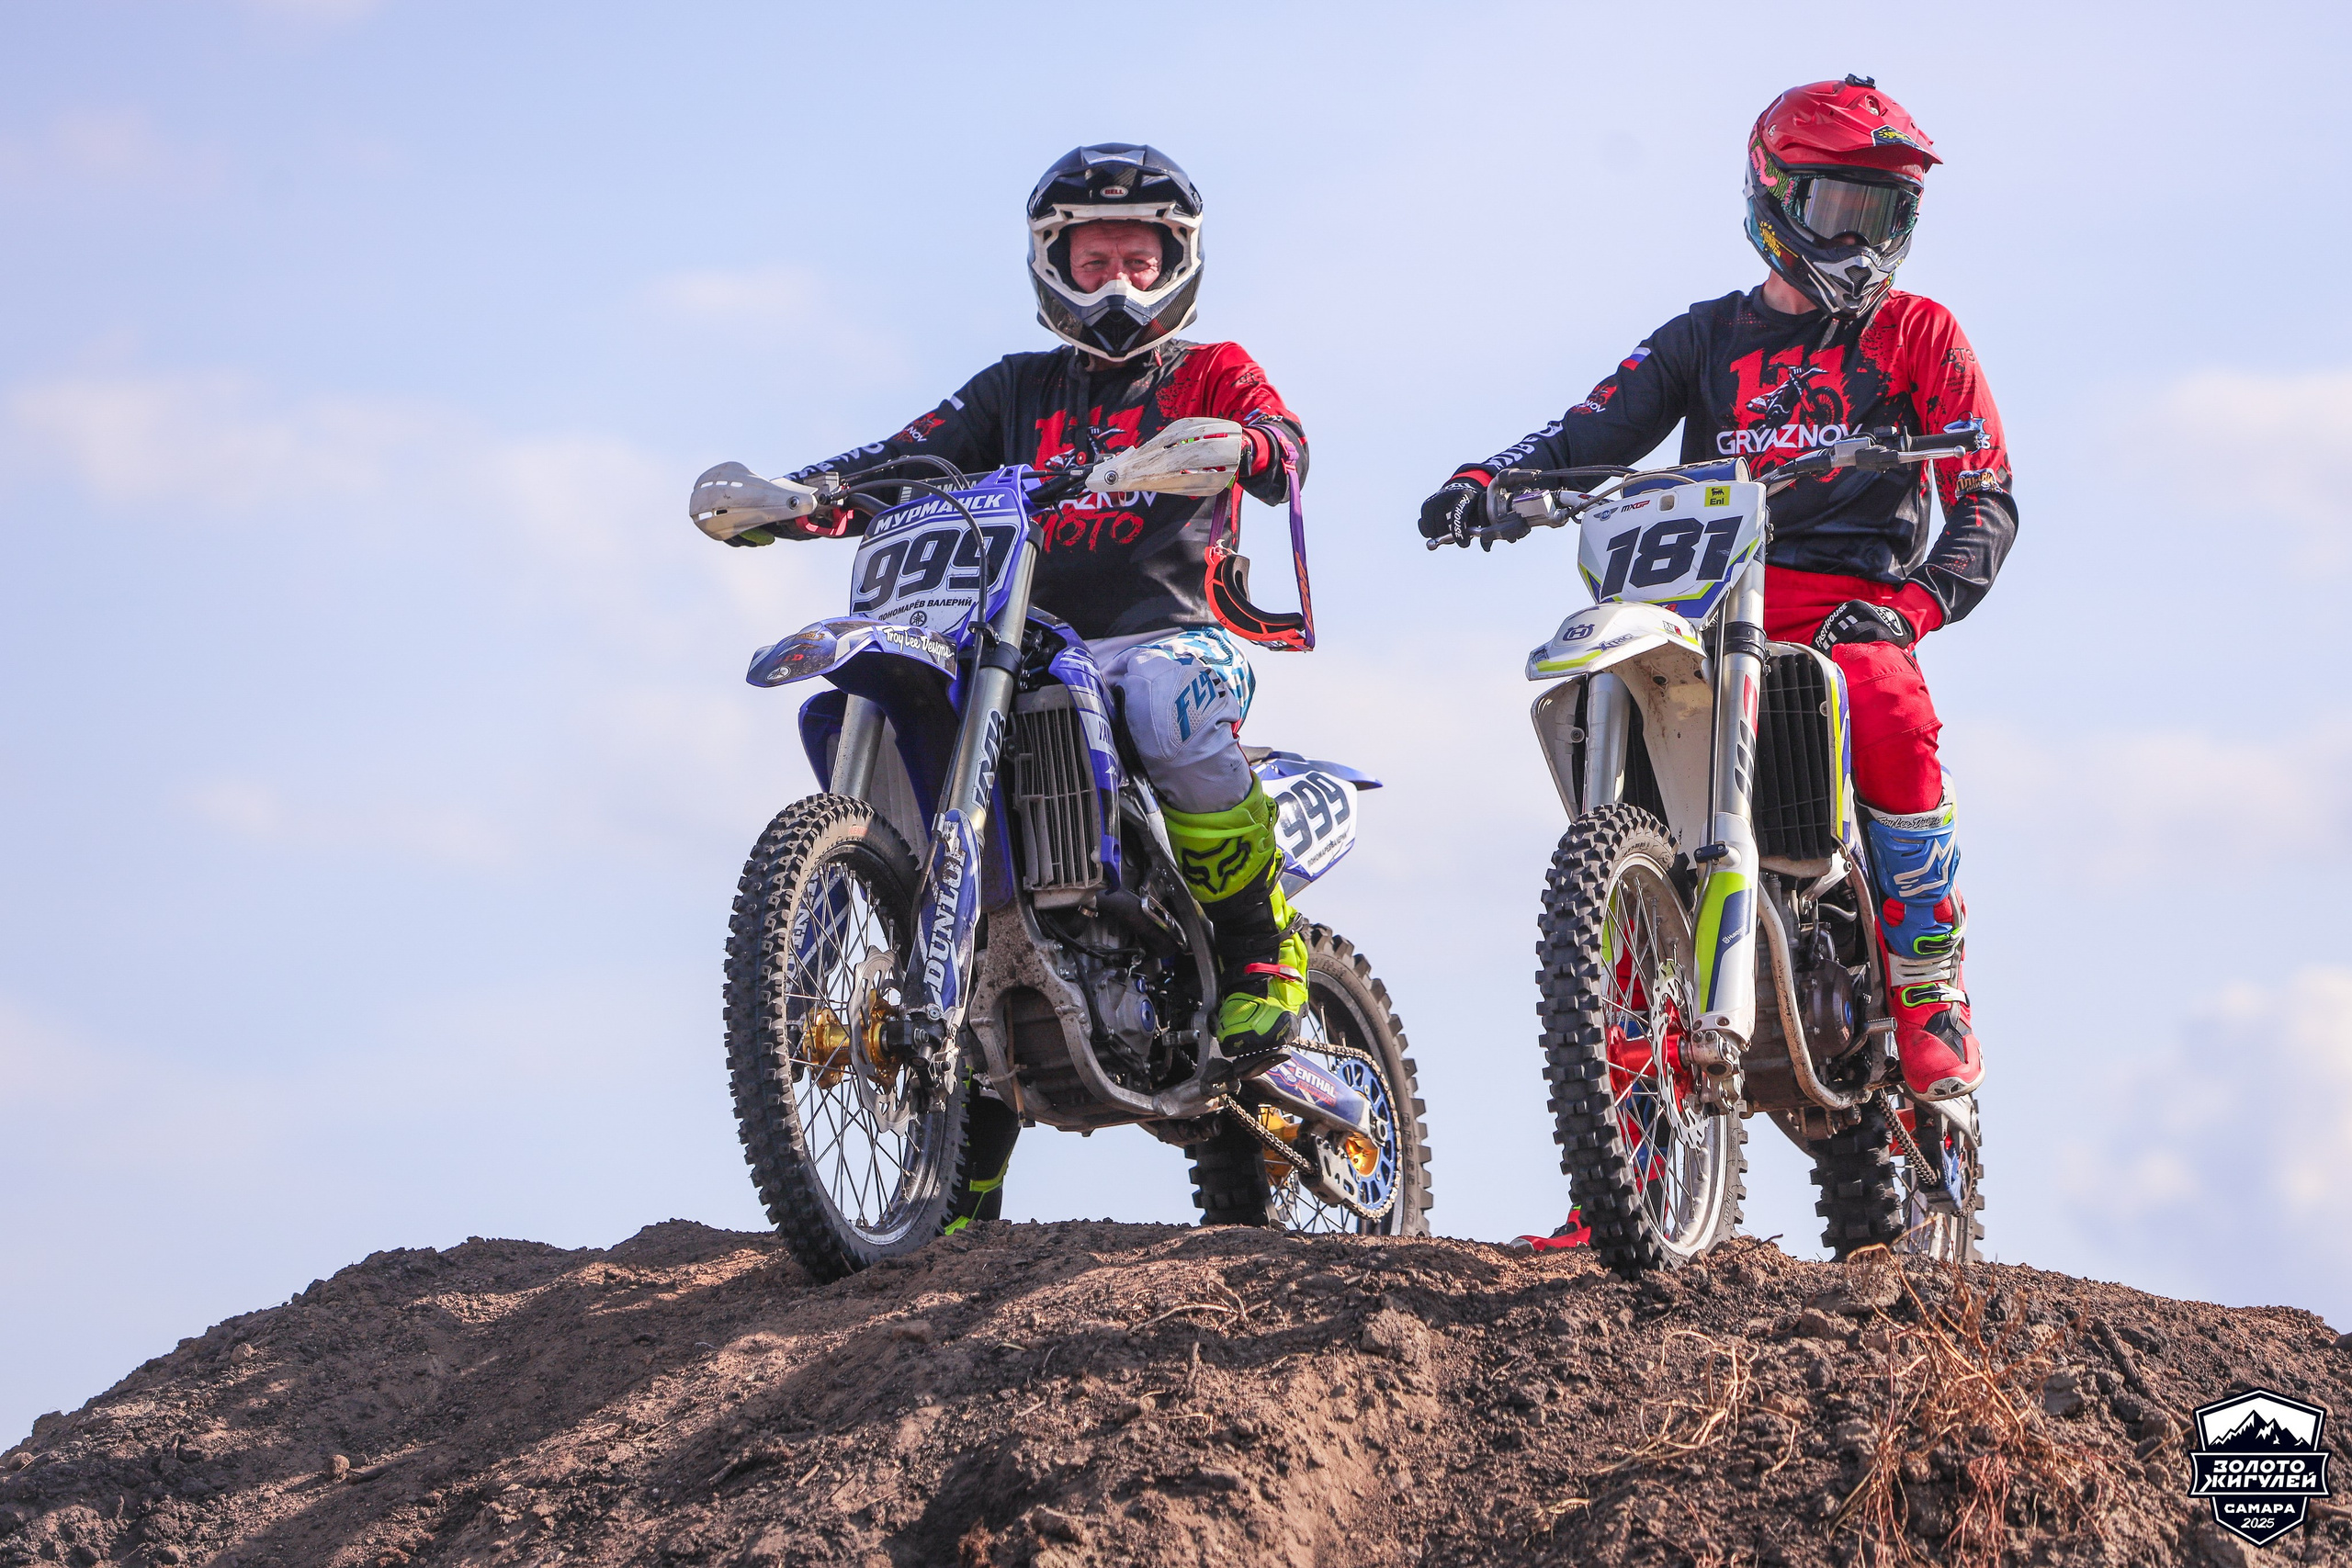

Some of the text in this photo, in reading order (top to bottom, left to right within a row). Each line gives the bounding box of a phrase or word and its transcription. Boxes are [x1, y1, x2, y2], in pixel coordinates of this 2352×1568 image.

[874, 493, 1004, 536] МУРМАНСК
[1621, 500, 1650, 513] MXGP
[852, 525, 1016, 614] 999
[1600, 515, 1744, 599] 181
[878, 597, 972, 621] ПОНОМАРЁВ ВАЛЕРИЙ
[1815, 602, 1848, 649] FASTHOUSE
[883, 627, 955, 661] Troy Lee Designs
[1274, 773, 1351, 860] 999
